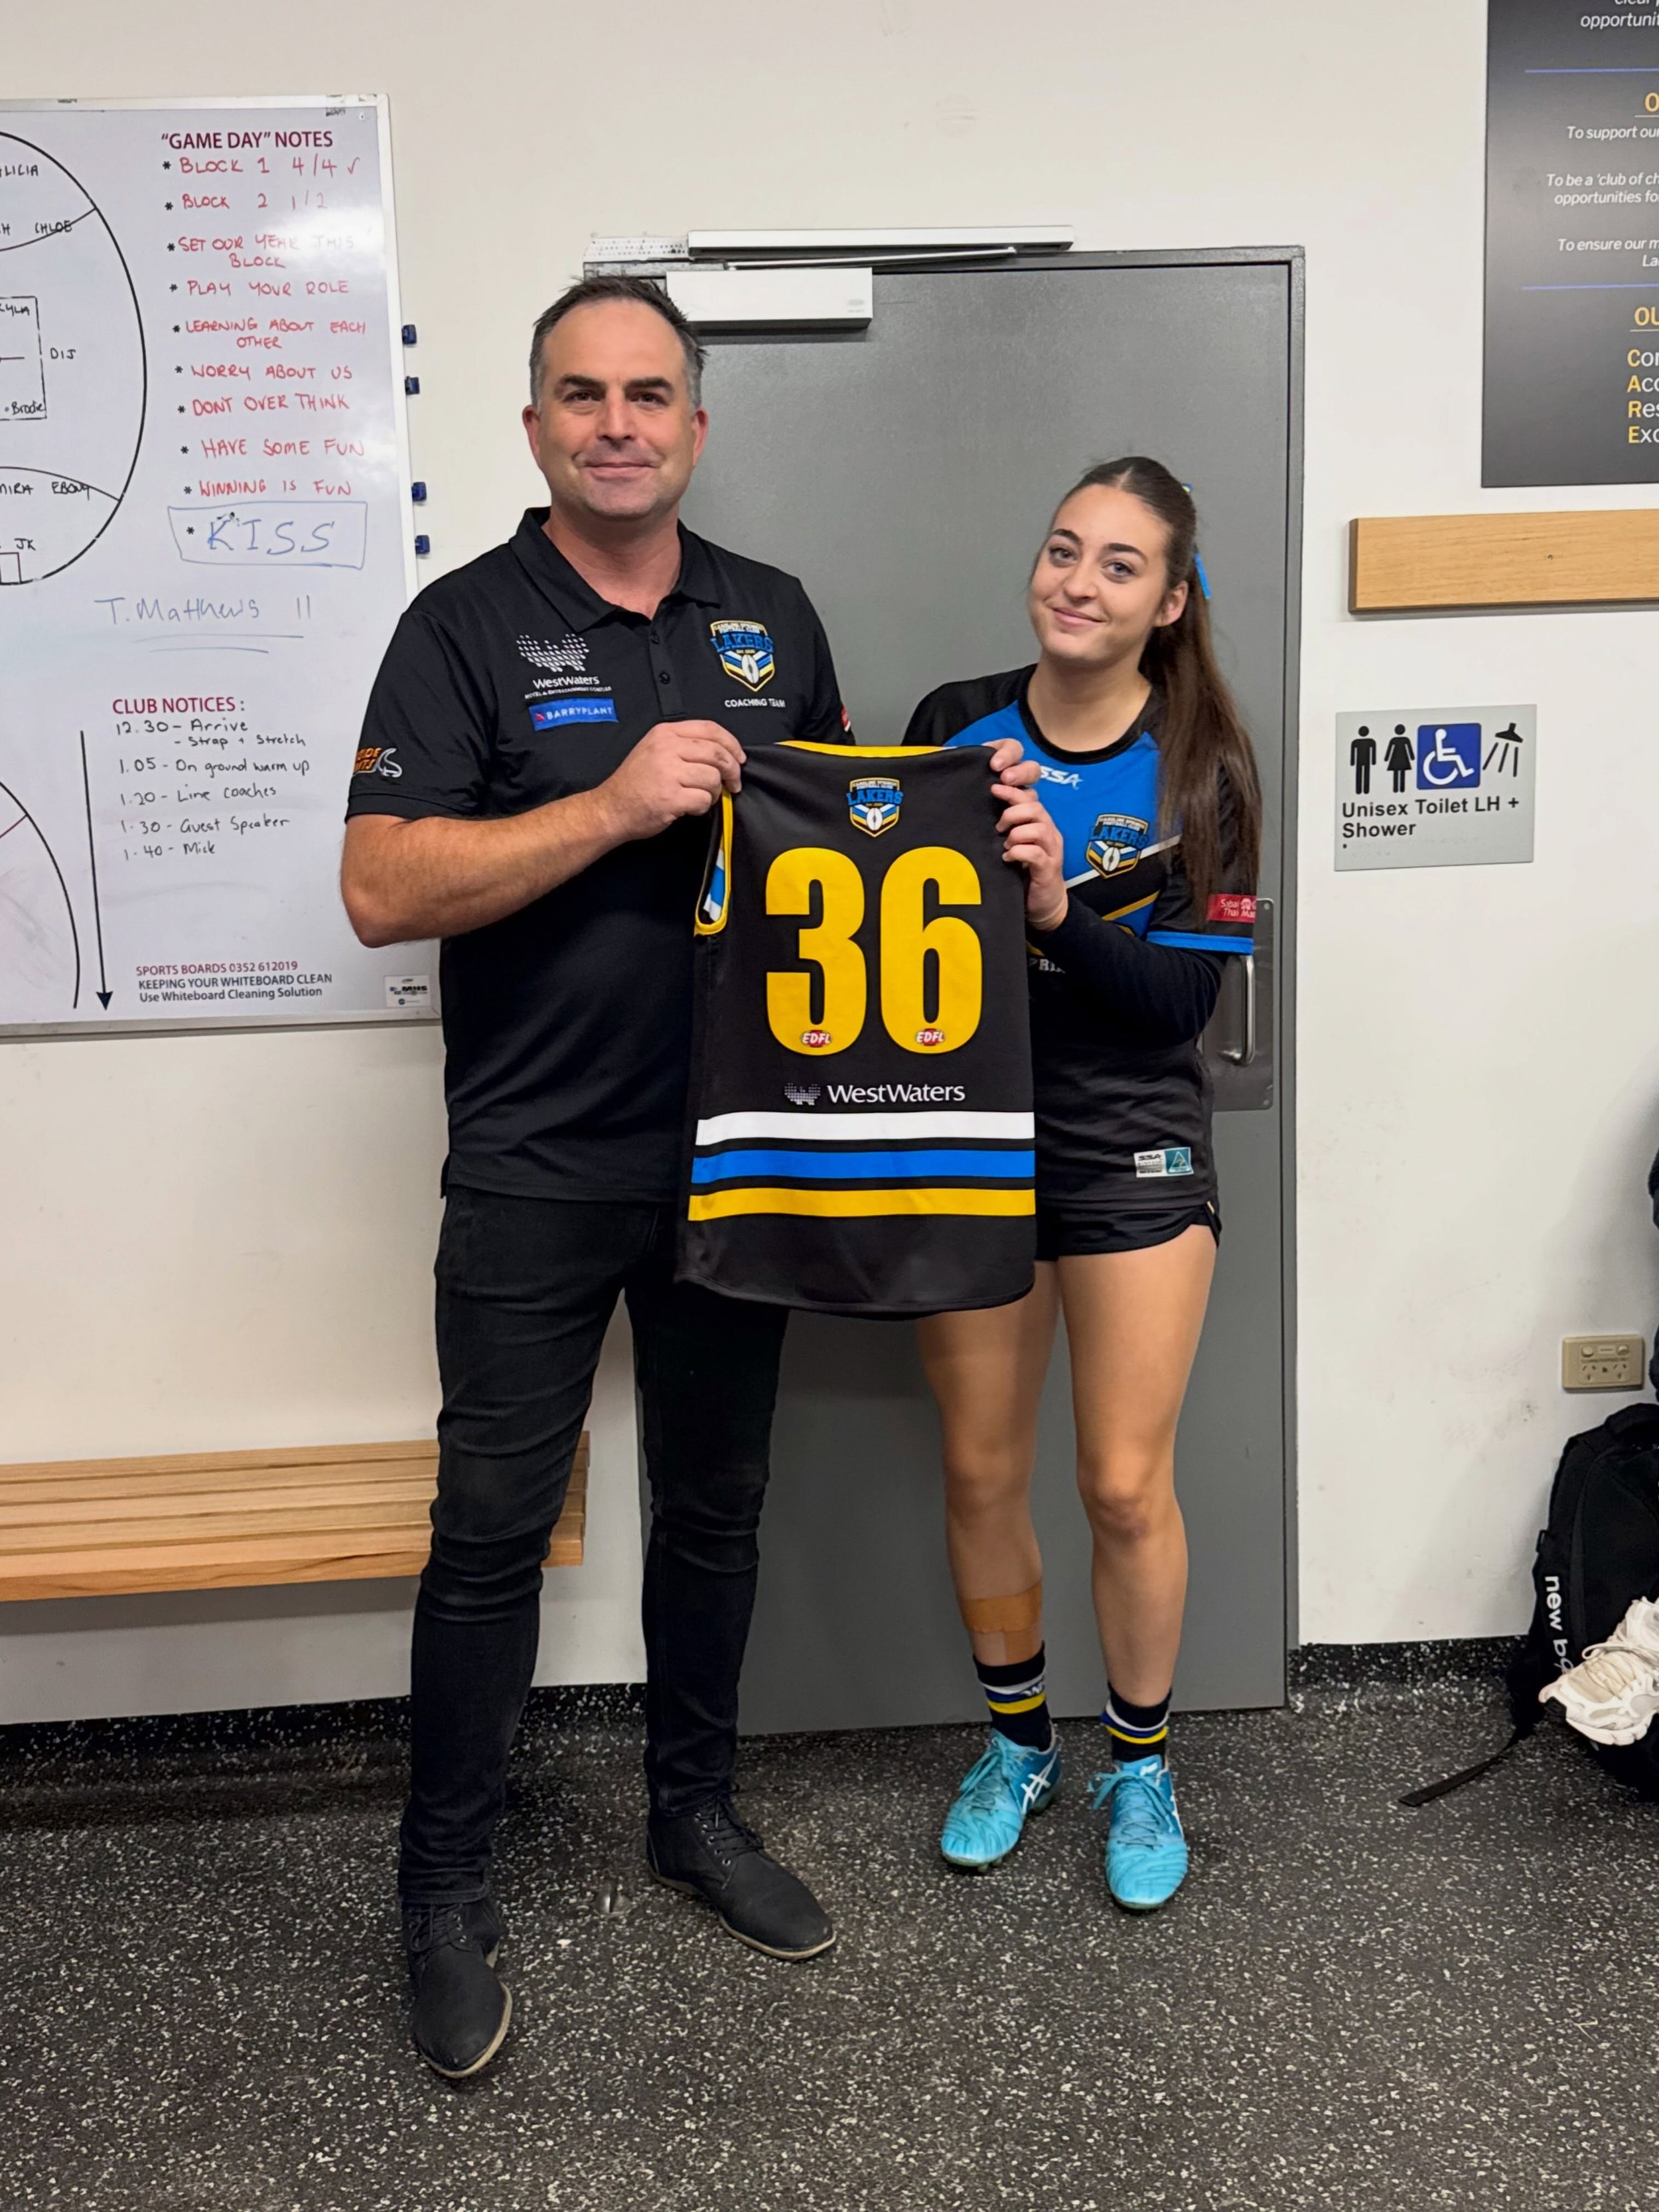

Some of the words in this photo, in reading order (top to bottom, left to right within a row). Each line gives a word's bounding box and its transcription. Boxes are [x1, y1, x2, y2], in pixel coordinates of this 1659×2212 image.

[275, 131, 333, 147] NOTES
[1567, 126, 1584, 139] To
[1586, 125, 1638, 141] support
[0, 164, 38, 177] LICIA
[180, 157, 243, 173] BLOCK
[257, 157, 269, 173] 1
[1547, 173, 1563, 186] To
[1565, 173, 1583, 186] be
[1585, 177, 1593, 186] a
[1628, 172, 1644, 185] of
[182, 193, 230, 209] BLOCK
[257, 192, 267, 208] 2
[1554, 190, 1642, 206] opportunities
[1645, 190, 1659, 202] fo
[35, 220, 72, 236] CHLOE
[178, 237, 206, 252] SET
[212, 236, 244, 250] OUR
[1558, 238, 1575, 252] To
[1577, 240, 1622, 251] ensure
[1624, 240, 1647, 250] our
[229, 253, 285, 268] BLOCK
[1642, 254, 1659, 267] La
[187, 280, 231, 296] PLAY
[249, 281, 291, 296] YOUR
[306, 280, 349, 295] ROLE
[186, 317, 258, 332] LEARNING
[269, 319, 315, 332] ABOUT
[330, 321, 366, 334] EACH
[236, 336, 282, 349] OTHER
[191, 364, 251, 380] WORRY
[265, 364, 316, 379] ABOUT
[331, 366, 352, 380] US
[192, 397, 232, 416] DONT
[244, 395, 289, 411] OVER
[295, 393, 350, 412] THINK
[201, 438, 247, 459] HAVE
[263, 439, 310, 456] SOME
[324, 438, 364, 456] FUN
[199, 479, 266, 497] WINNING
[283, 480, 297, 492] IS
[313, 479, 351, 496] FUN
[207, 518, 334, 555] KISS
[710, 632, 774, 653] LAKERS
[532, 676, 600, 689] WestWaters
[112, 698, 157, 715] CLUB
[725, 698, 767, 708] COACHING
[768, 698, 786, 707] TEAM
[190, 717, 248, 732] Arrive
[188, 735, 228, 751] Strap
[176, 759, 197, 772] On
[204, 758, 248, 778] ground
[253, 761, 287, 772] warm
[293, 761, 310, 776] up
[177, 784, 211, 802] Line
[845, 788, 904, 806] LAKERS
[1342, 802, 1408, 818] Unisex
[1414, 798, 1468, 814] Toilet
[1475, 796, 1500, 812] LH
[180, 818, 221, 834] Guest
[230, 813, 291, 835] Speaker
[1342, 822, 1416, 838] Shower
[1089, 826, 1149, 850] LAKERS
[766, 846, 982, 1056] 36
[136, 965, 179, 976] SPORTS
[181, 963, 227, 975] BOARDS
[229, 962, 255, 973] 0352
[258, 961, 298, 972] 612019
[139, 979, 186, 990] KEEPING
[188, 977, 218, 988] YOUR
[220, 975, 294, 988] WHITEBOARD
[297, 974, 332, 984] CLEAN
[139, 993, 159, 1002] Use
[161, 990, 225, 1001] Whiteboard
[228, 988, 275, 1000] Cleaning
[277, 987, 322, 997] Solution
[802, 1032, 831, 1045] EDFL
[916, 1031, 944, 1043] EDFL
[827, 1084, 966, 1104] WestWaters
[1545, 1576, 1563, 1631] new
